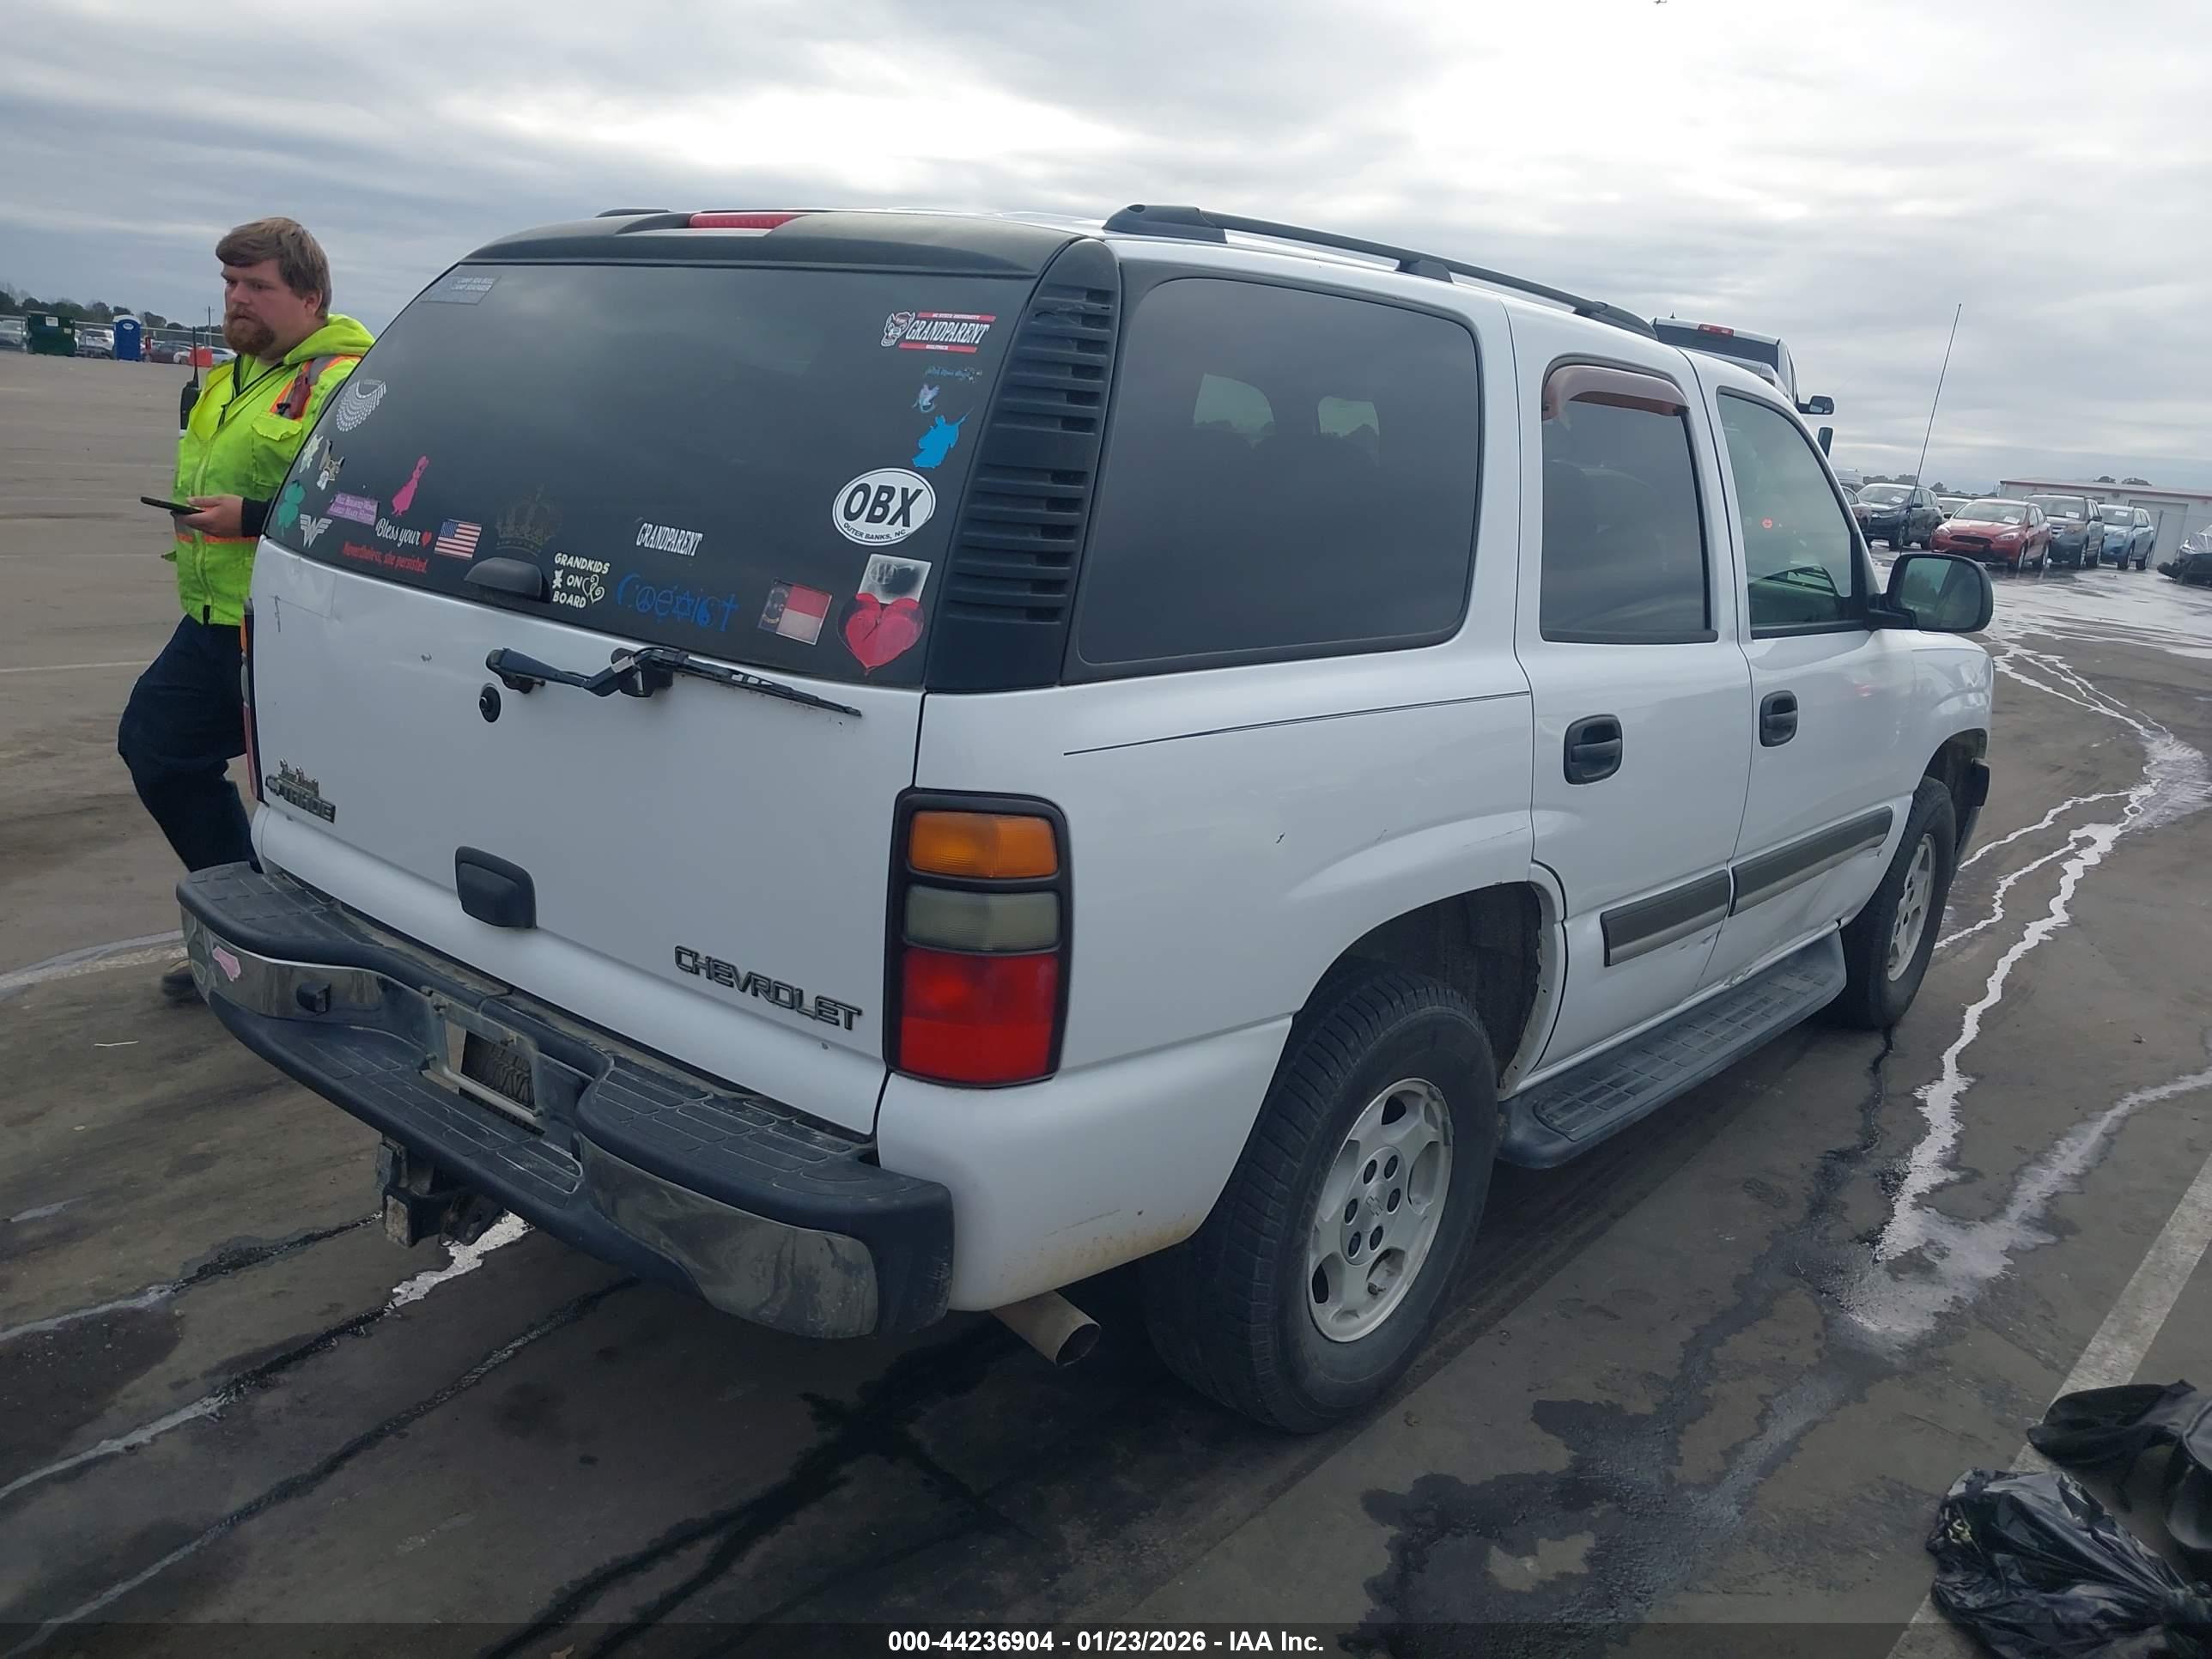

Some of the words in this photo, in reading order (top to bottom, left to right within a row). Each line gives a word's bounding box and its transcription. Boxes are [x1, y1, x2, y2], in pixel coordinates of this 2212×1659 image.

[905, 319, 990, 343] GRANDPARENT
[843, 483, 924, 528] OBX
[375, 517, 398, 541] Bless
[398, 527, 422, 548] your
[635, 522, 703, 556] GRANDPARENT
[843, 522, 864, 537] OUTER
[864, 532, 892, 541] BANKS,
[894, 529, 907, 538] NC
[554, 552, 611, 574] GRANDKIDS
[566, 574, 583, 589] ON
[552, 590, 586, 609] BOARD
[674, 945, 863, 1031] CHEVROLET
